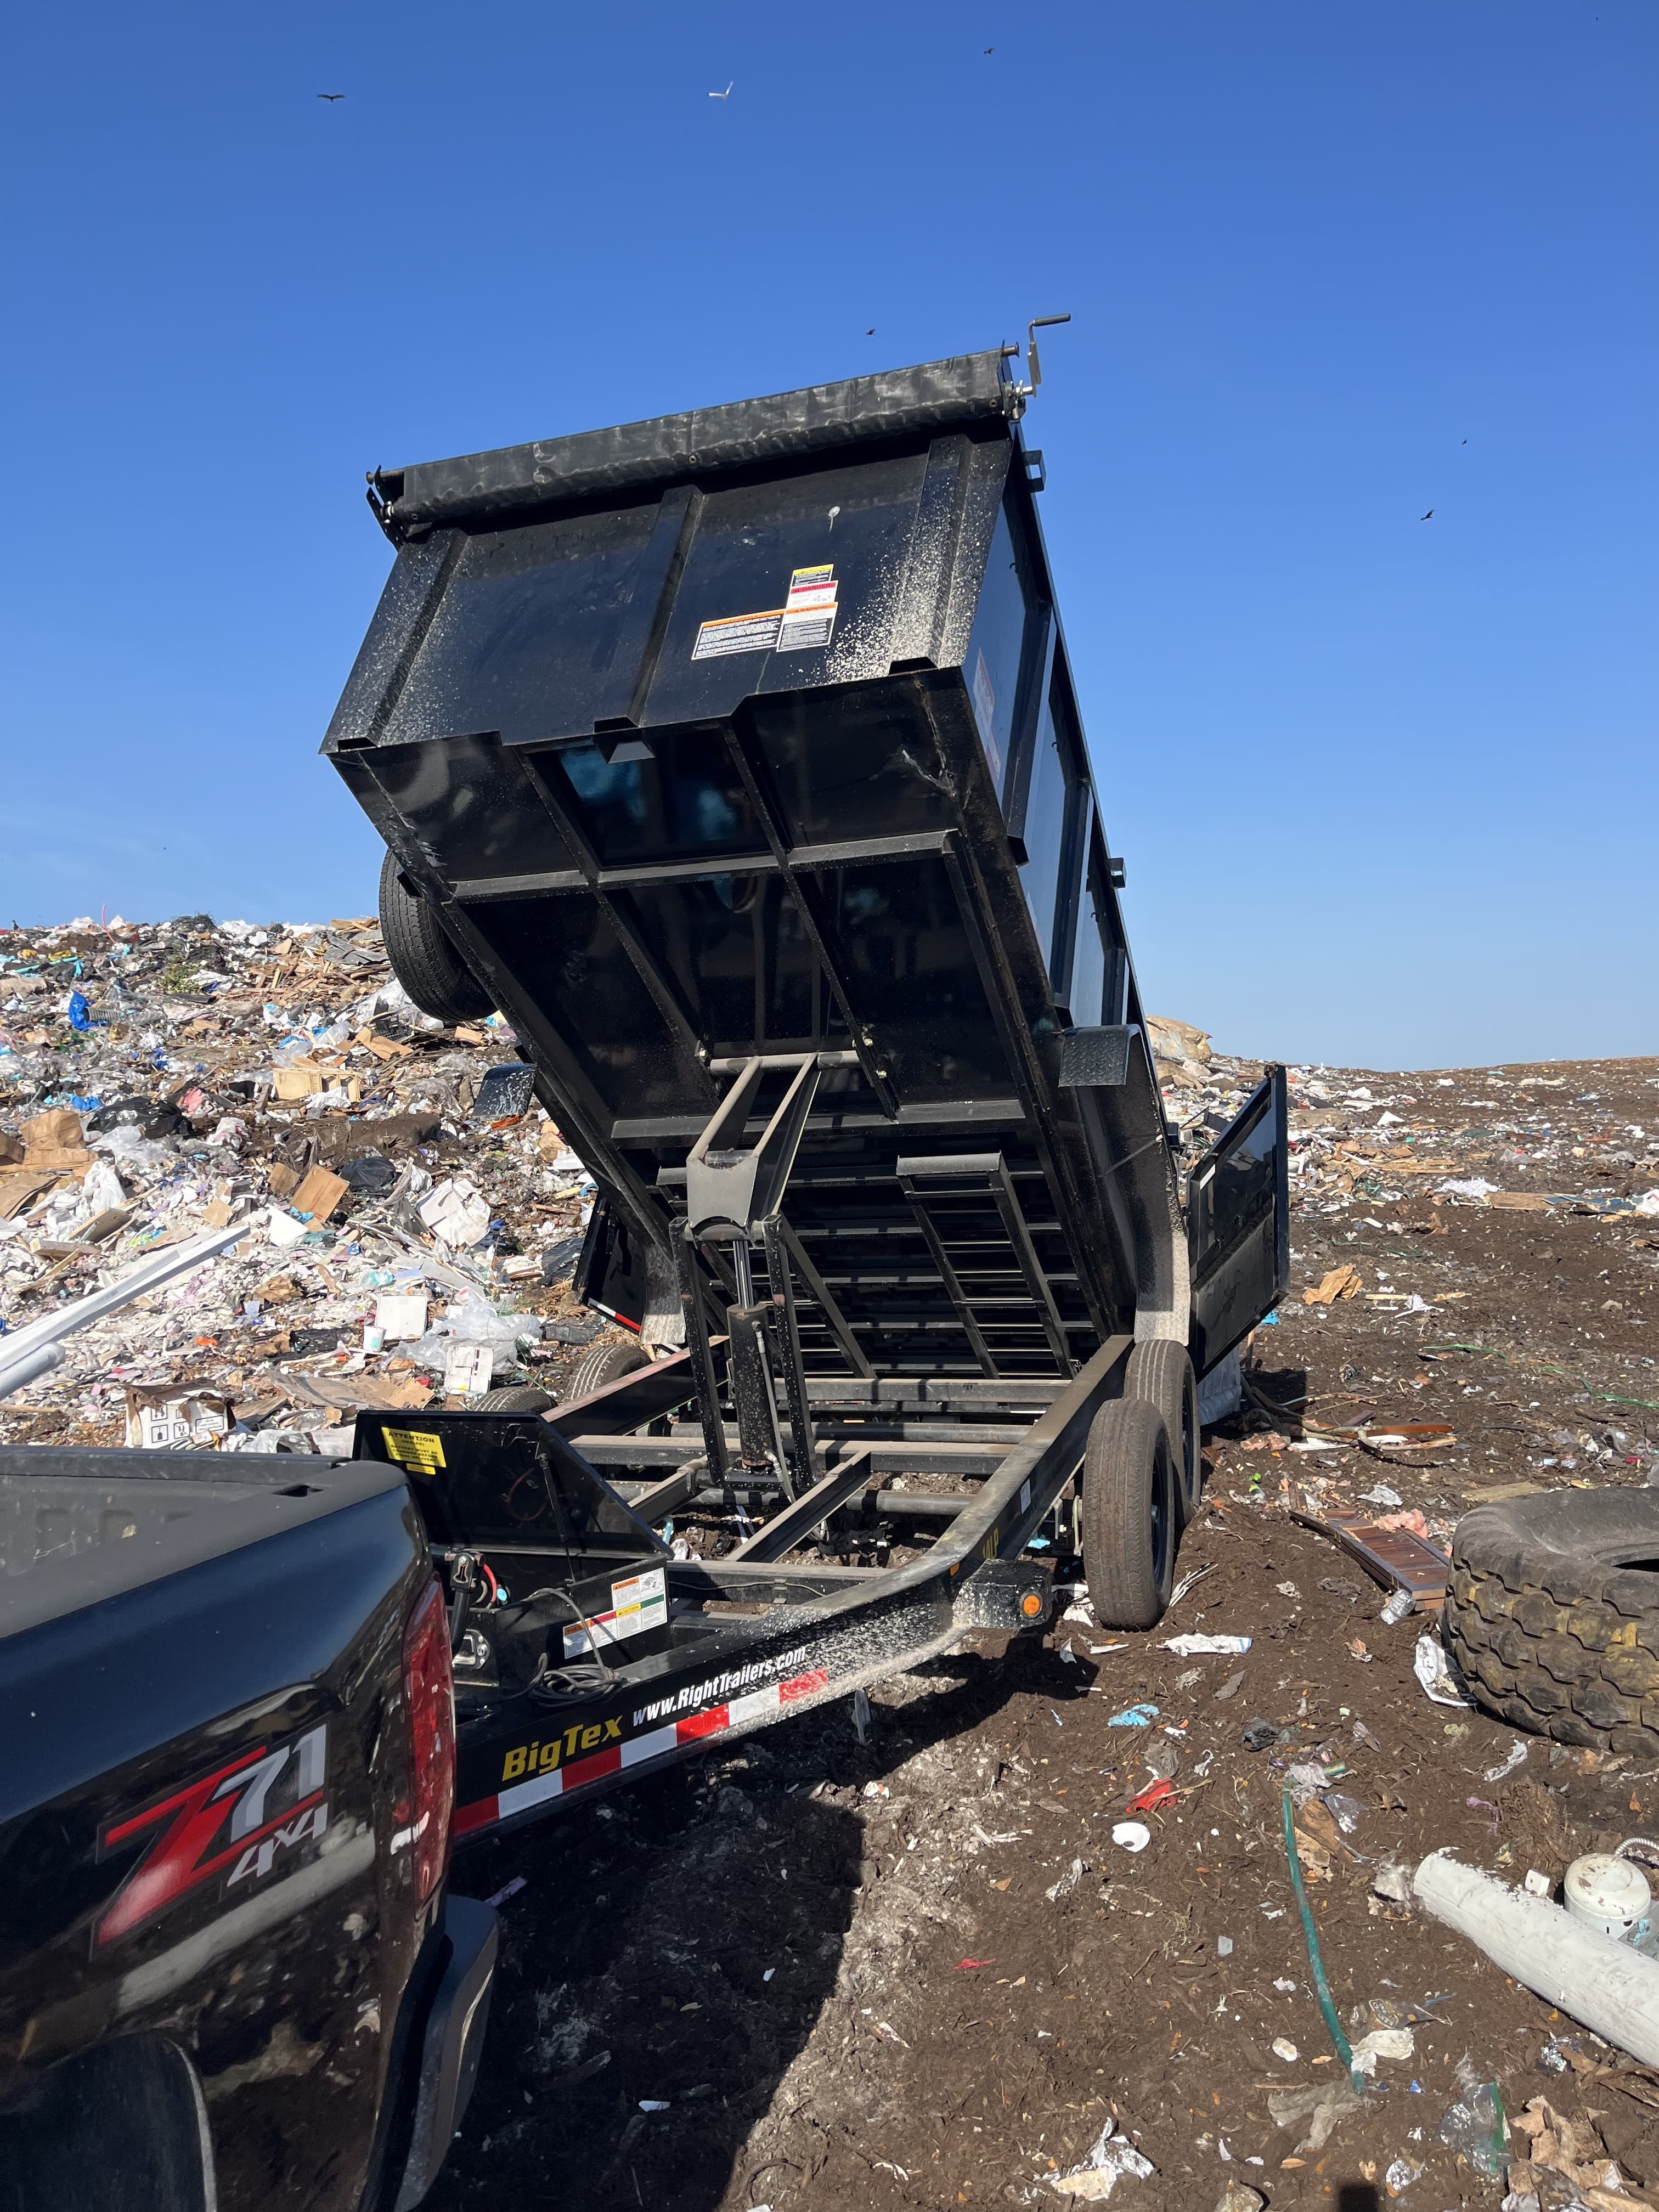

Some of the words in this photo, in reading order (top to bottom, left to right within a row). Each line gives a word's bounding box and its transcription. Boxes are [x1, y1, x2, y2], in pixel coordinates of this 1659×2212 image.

[802, 583, 831, 592] DANGER
[388, 1432, 435, 1443] ATTENTION
[622, 1605, 639, 1614] CAUTION
[633, 1646, 806, 1727] www.RightTrailers.com
[97, 1723, 328, 1945] Z71
